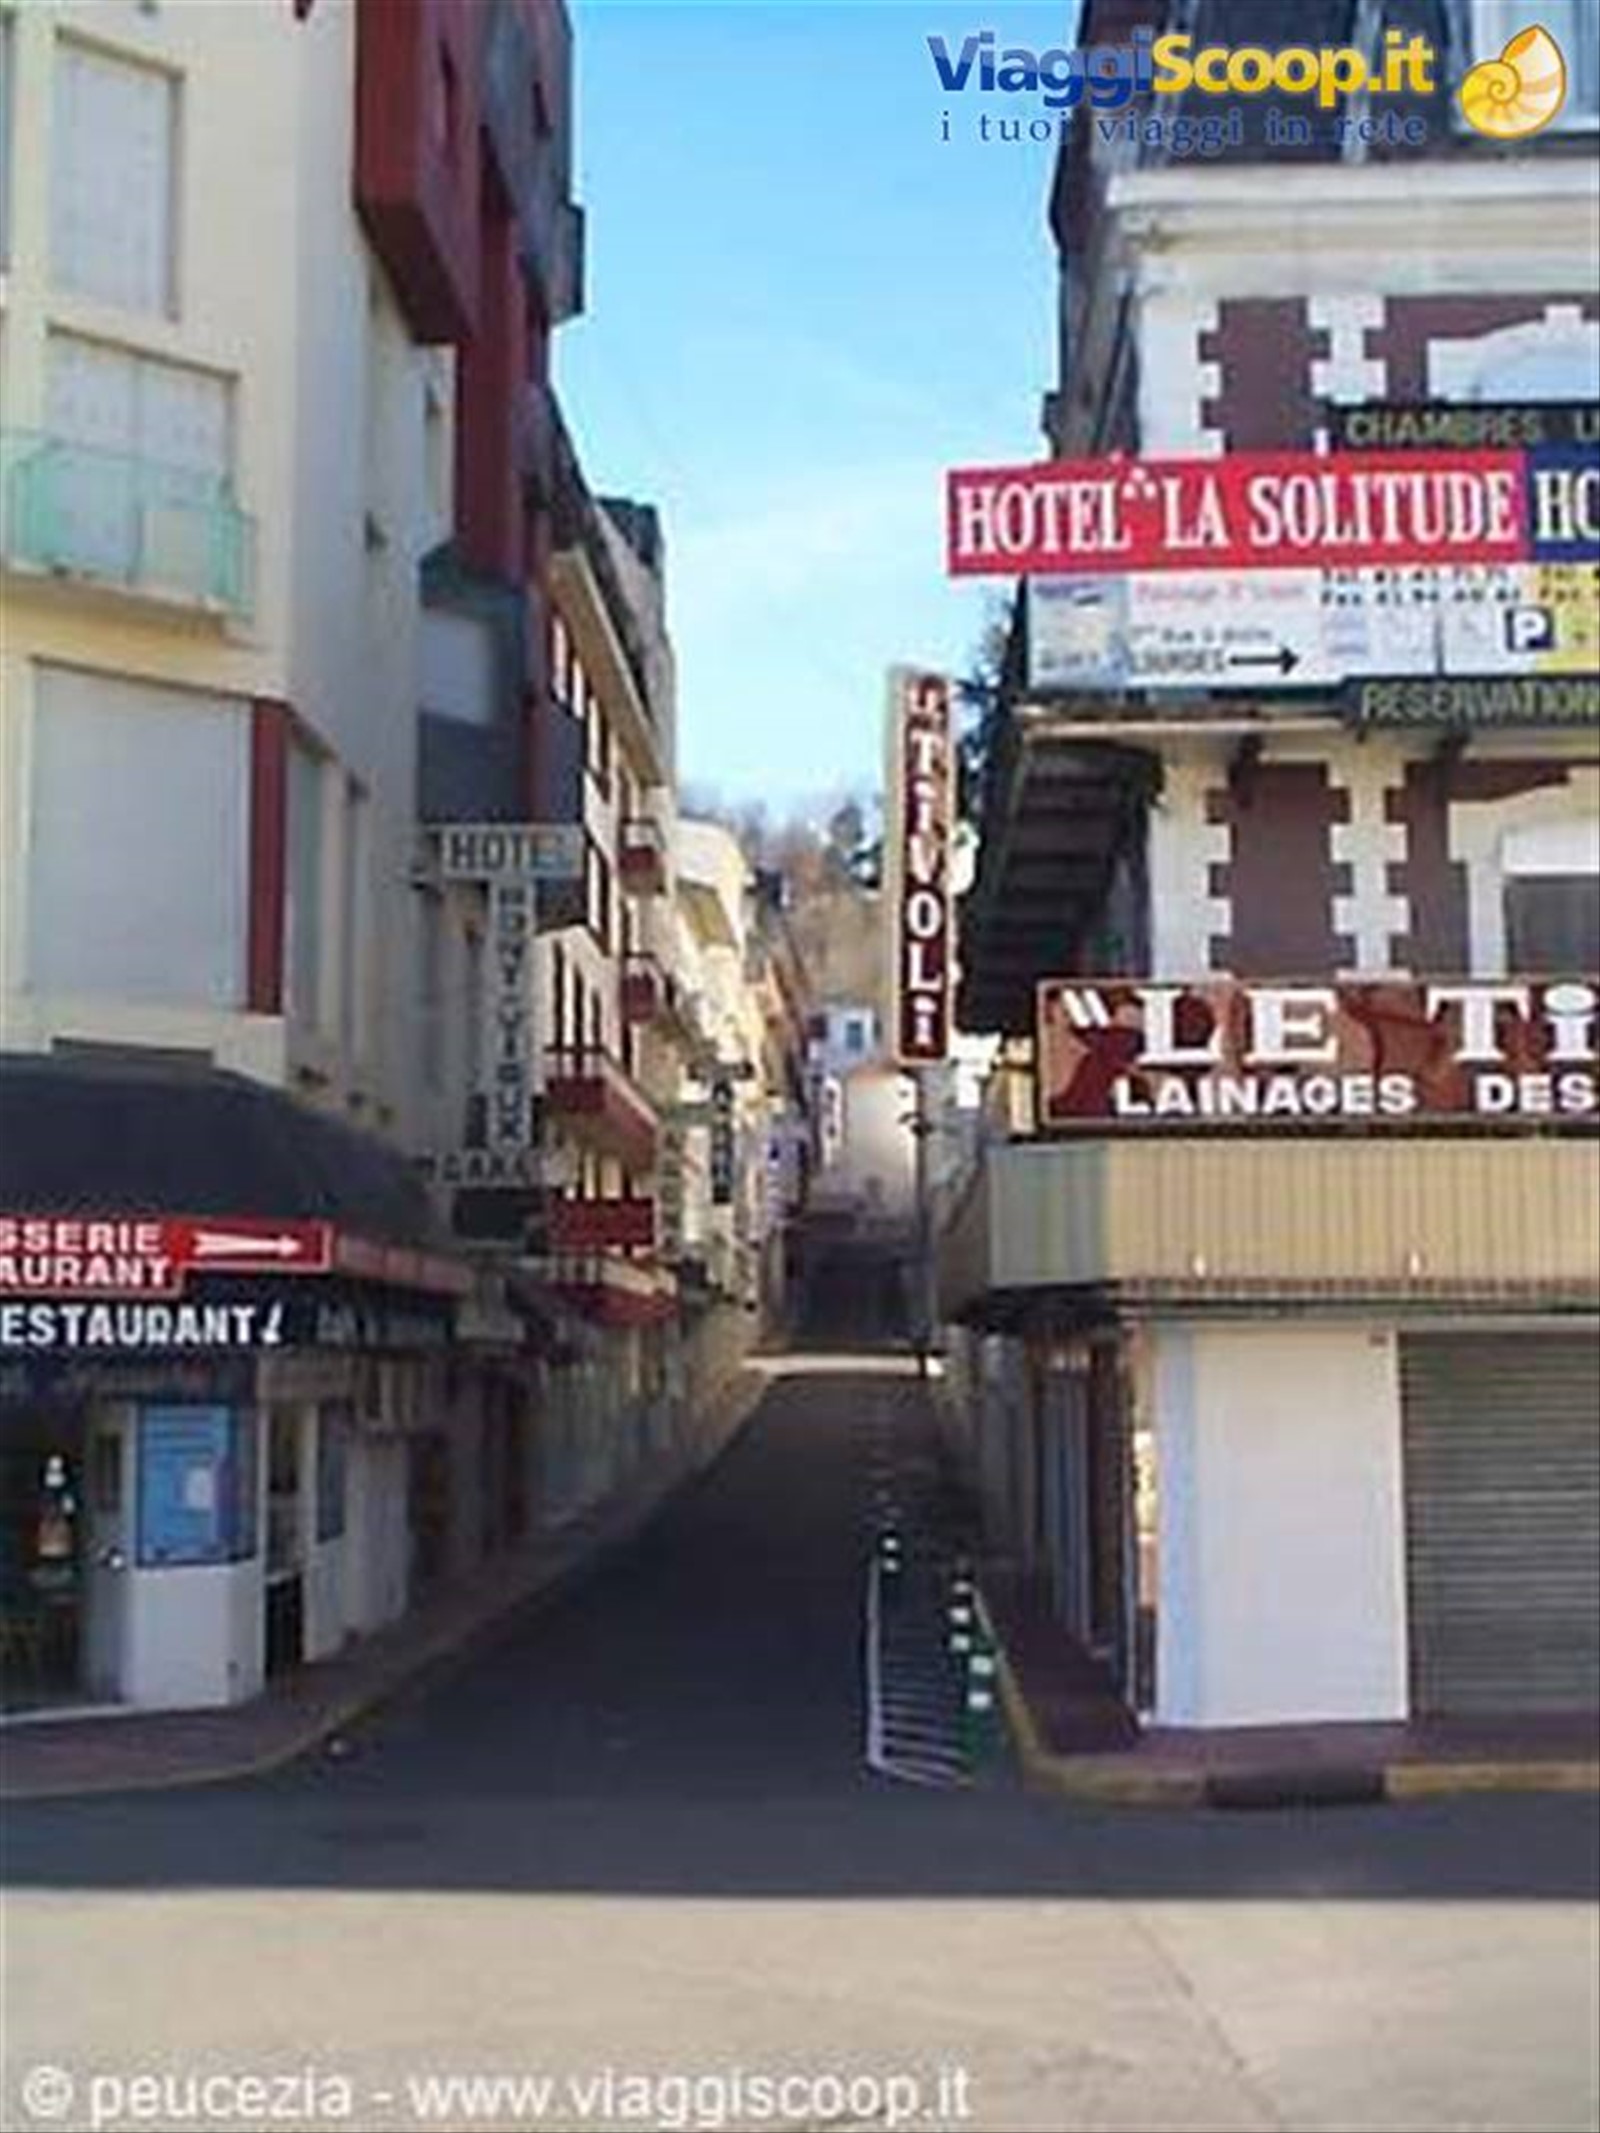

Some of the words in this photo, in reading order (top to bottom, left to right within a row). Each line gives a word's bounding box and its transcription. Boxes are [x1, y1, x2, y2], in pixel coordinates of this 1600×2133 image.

[1346, 409, 1542, 444] CHAMBRES
[956, 479, 1132, 555] HOTEL
[1162, 474, 1231, 549] LA
[1248, 468, 1520, 548] SOLITUDE
[1113, 1073, 1416, 1114] LAINAGES
[1475, 1073, 1596, 1113] DES
